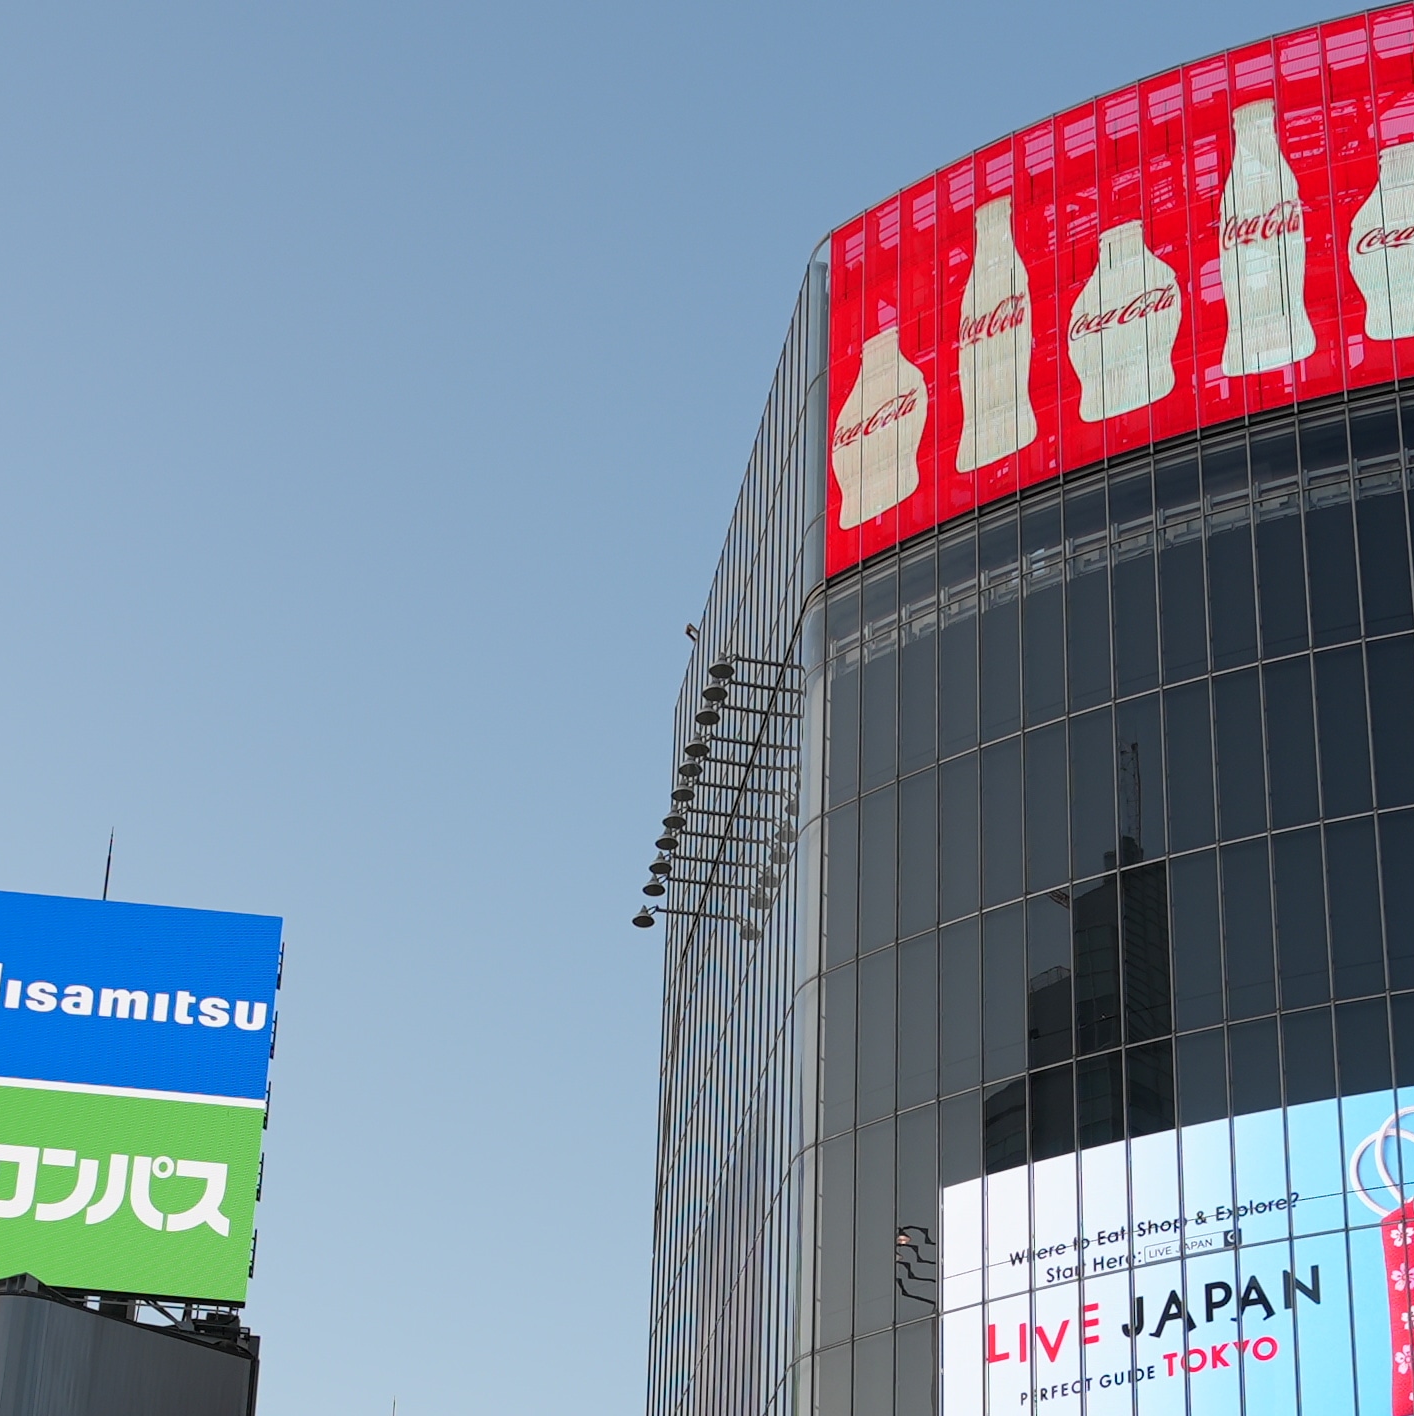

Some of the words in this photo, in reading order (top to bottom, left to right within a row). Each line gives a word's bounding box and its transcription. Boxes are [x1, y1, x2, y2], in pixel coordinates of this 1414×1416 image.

[1223, 200, 1300, 250] Coca-Cola
[961, 292, 1025, 350] oca-Cola
[1070, 284, 1176, 341] Coca-Cola
[833, 387, 918, 452] oca-Cola
[1009, 1242, 1066, 1267] Where
[1098, 1228, 1126, 1246] Eat
[1137, 1216, 1187, 1237] Shop
[1195, 1211, 1207, 1225] &
[1216, 1192, 1299, 1222] Explore?
[1046, 1263, 1085, 1283] Start
[1093, 1250, 1142, 1272] Here:
[1148, 1246, 1172, 1259] LIVE
[1175, 1238, 1213, 1254] JAPAN
[988, 1302, 1100, 1364] LIVE
[1121, 1265, 1321, 1339] JAPAN
[1020, 1377, 1093, 1406] PERFECT
[1100, 1365, 1156, 1389] GUIDE
[1163, 1336, 1279, 1378] TOKYO
